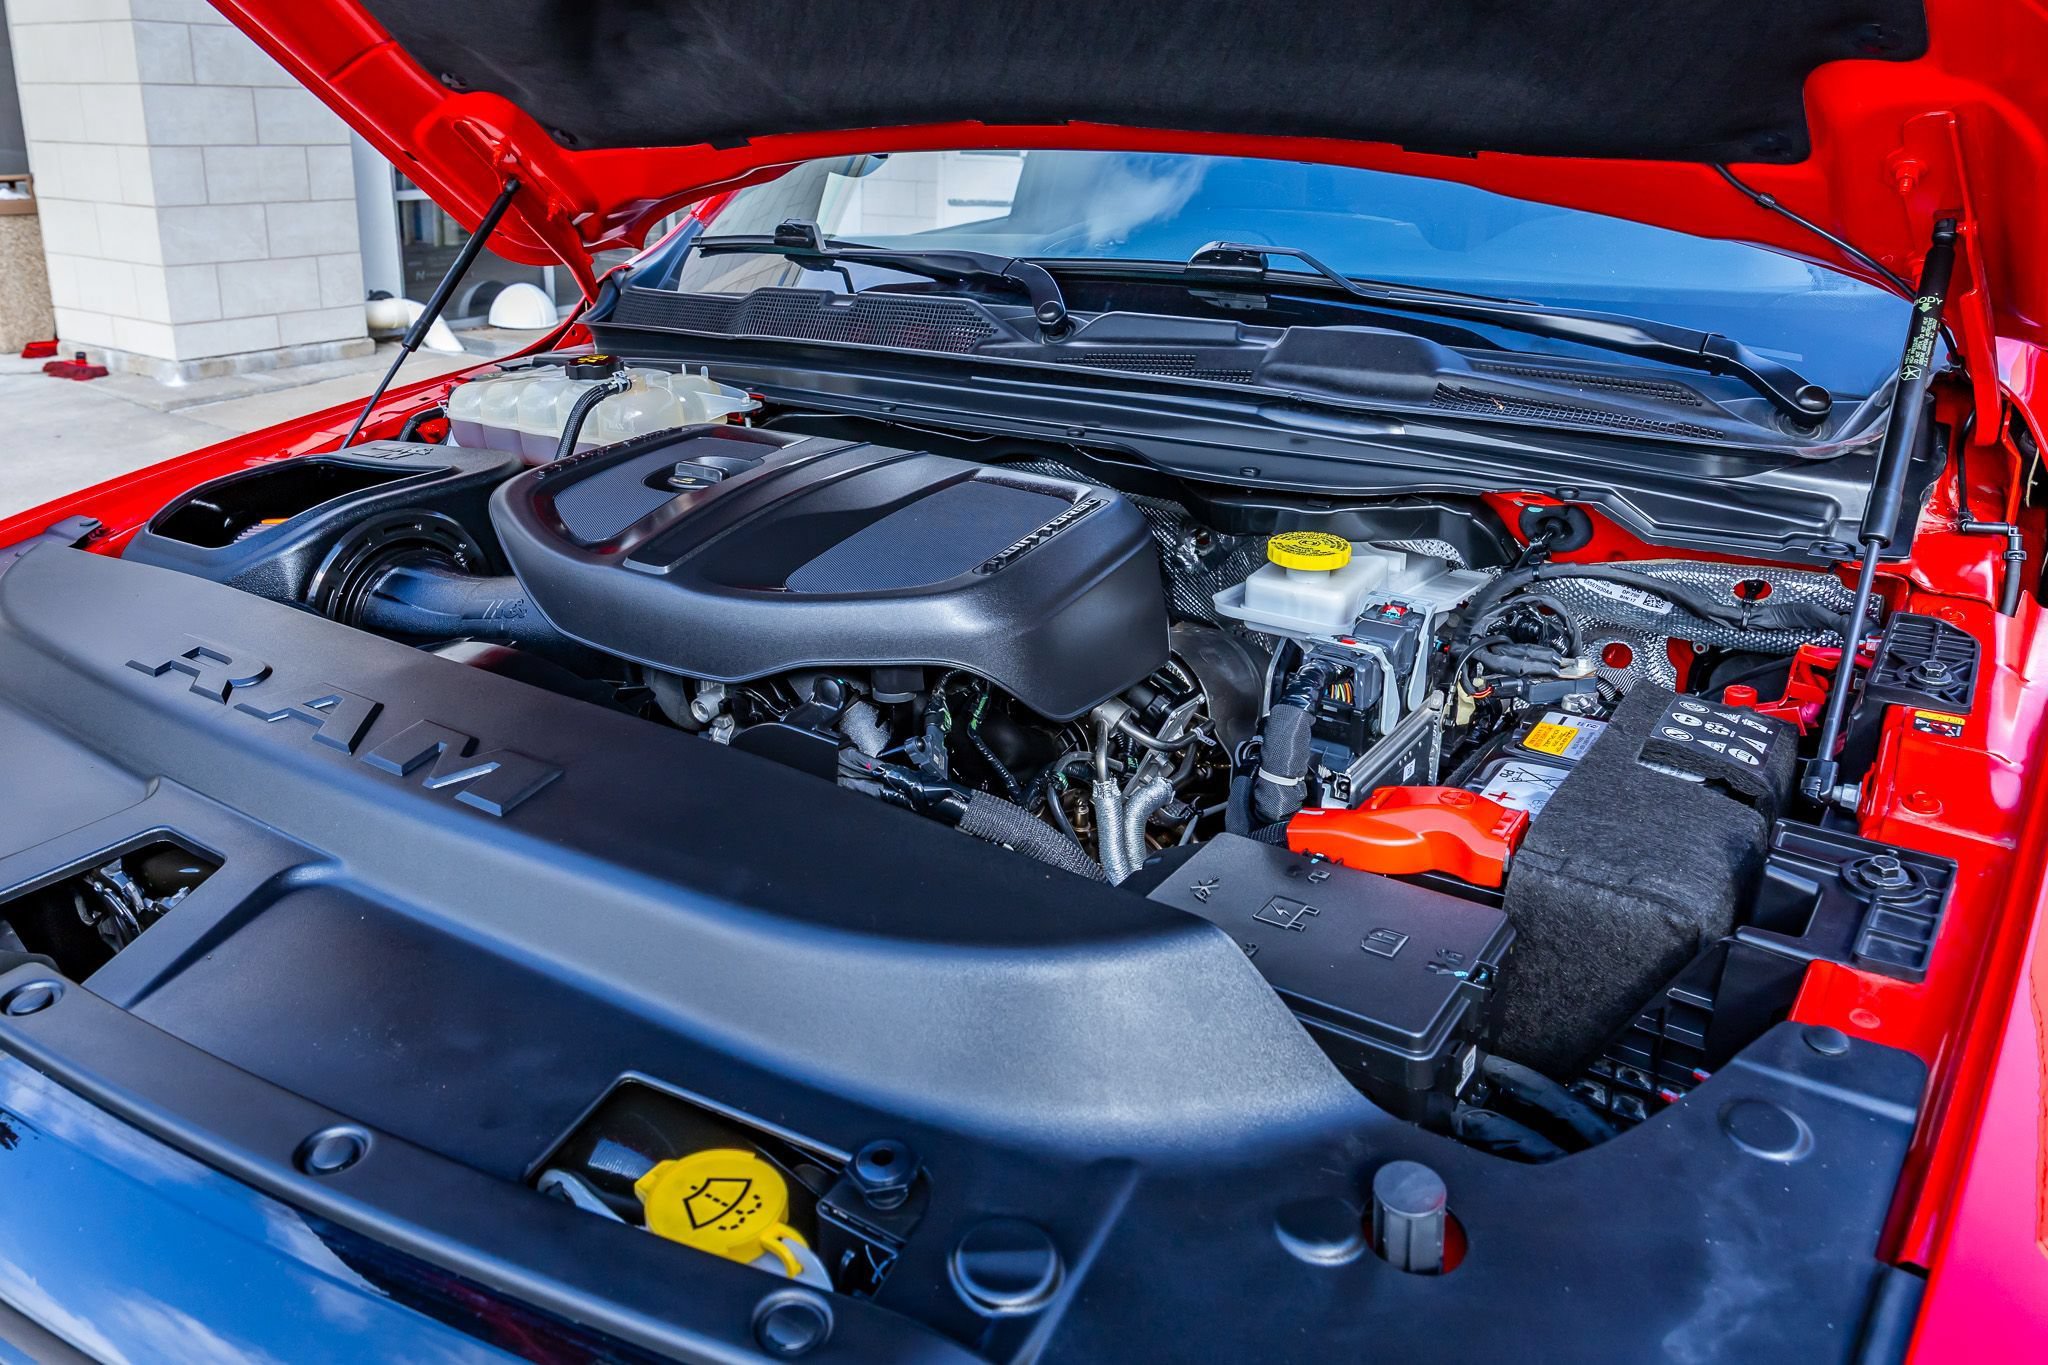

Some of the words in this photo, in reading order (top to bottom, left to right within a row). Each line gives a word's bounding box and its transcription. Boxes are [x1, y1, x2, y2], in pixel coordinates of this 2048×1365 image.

[1914, 296, 1943, 305] BODY
[981, 534, 1040, 573] TWIN
[1036, 498, 1101, 536] TURBO
[124, 632, 565, 818] RAM
